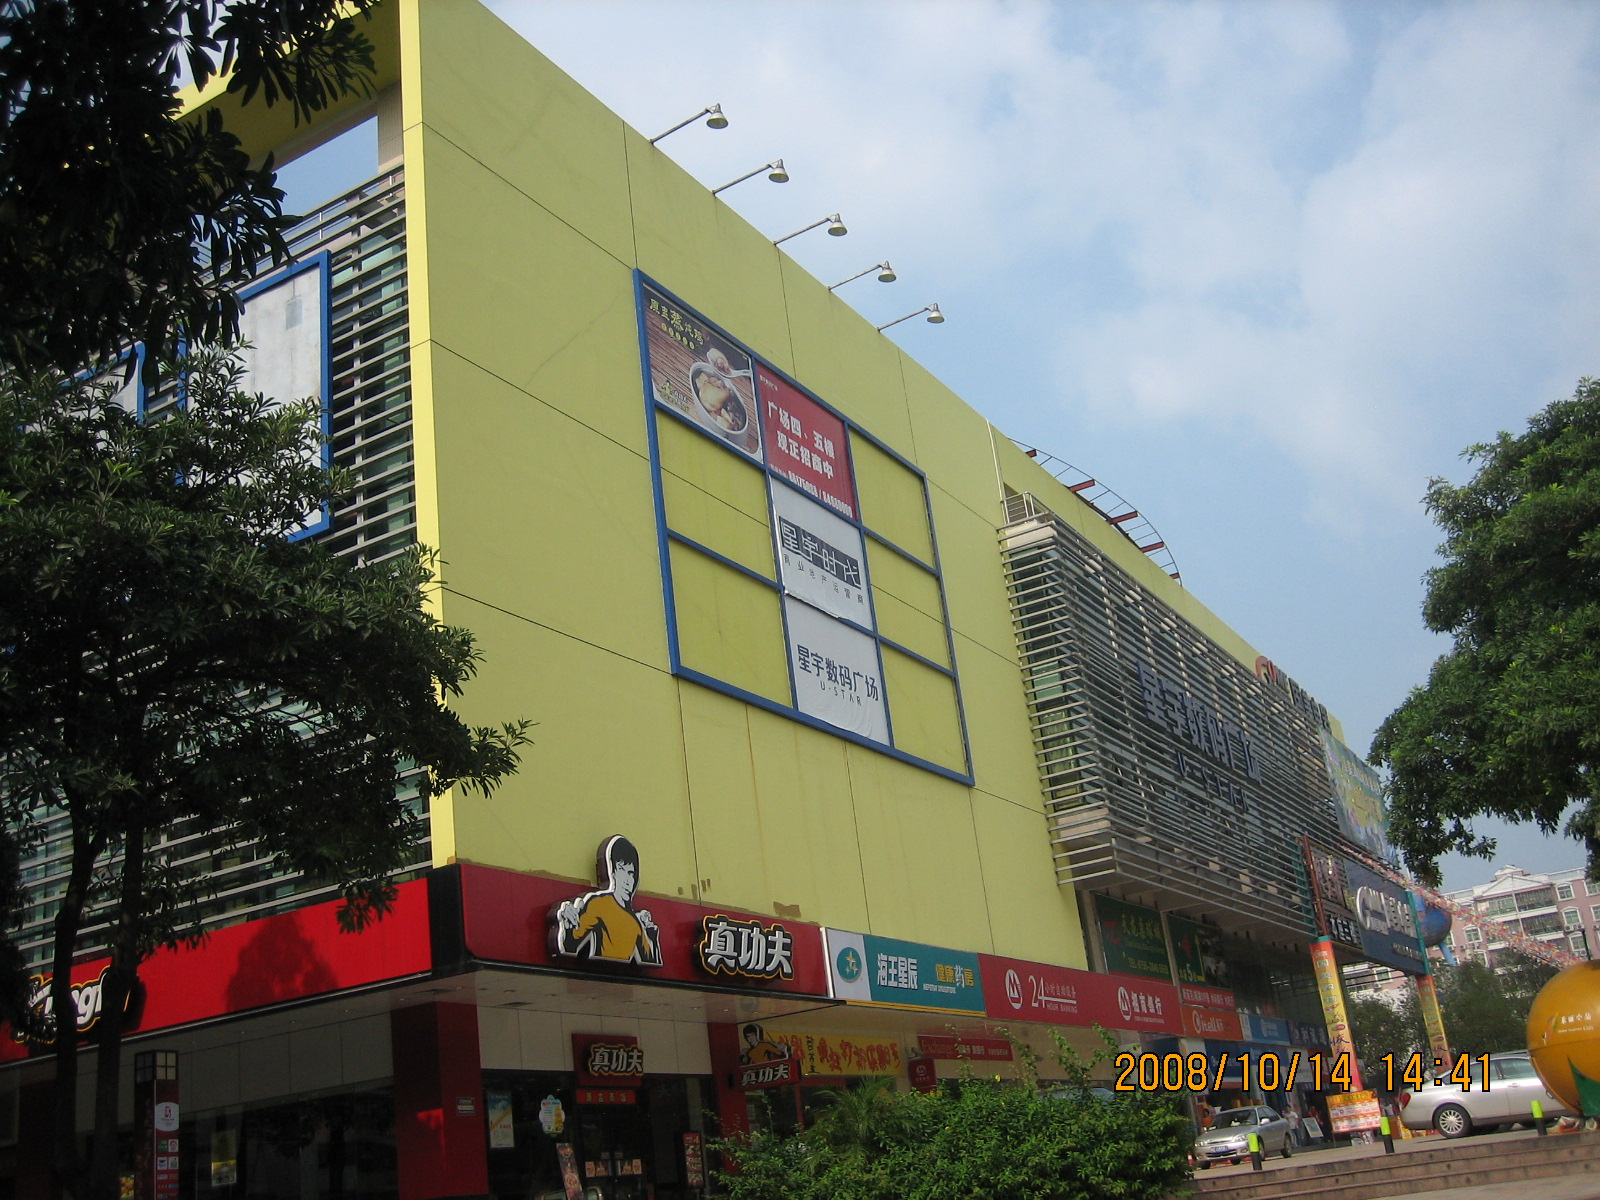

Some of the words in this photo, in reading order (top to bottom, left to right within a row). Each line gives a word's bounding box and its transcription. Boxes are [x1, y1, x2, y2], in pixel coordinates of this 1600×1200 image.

[767, 400, 835, 459] 广场四、五楼
[777, 430, 834, 480] 现正招商中
[797, 643, 879, 701] 星宇数码广场
[704, 921, 793, 974] 真功夫
[877, 952, 918, 990] 海王星辰
[935, 963, 974, 989] 健康药房
[1028, 975, 1046, 1009] 24
[1046, 1002, 1059, 1012] HOUR
[1060, 1004, 1078, 1014] BANKING
[1131, 990, 1163, 1016] 招商银行
[592, 1047, 643, 1072] 真功夫
[739, 1062, 791, 1087] 真功夫
